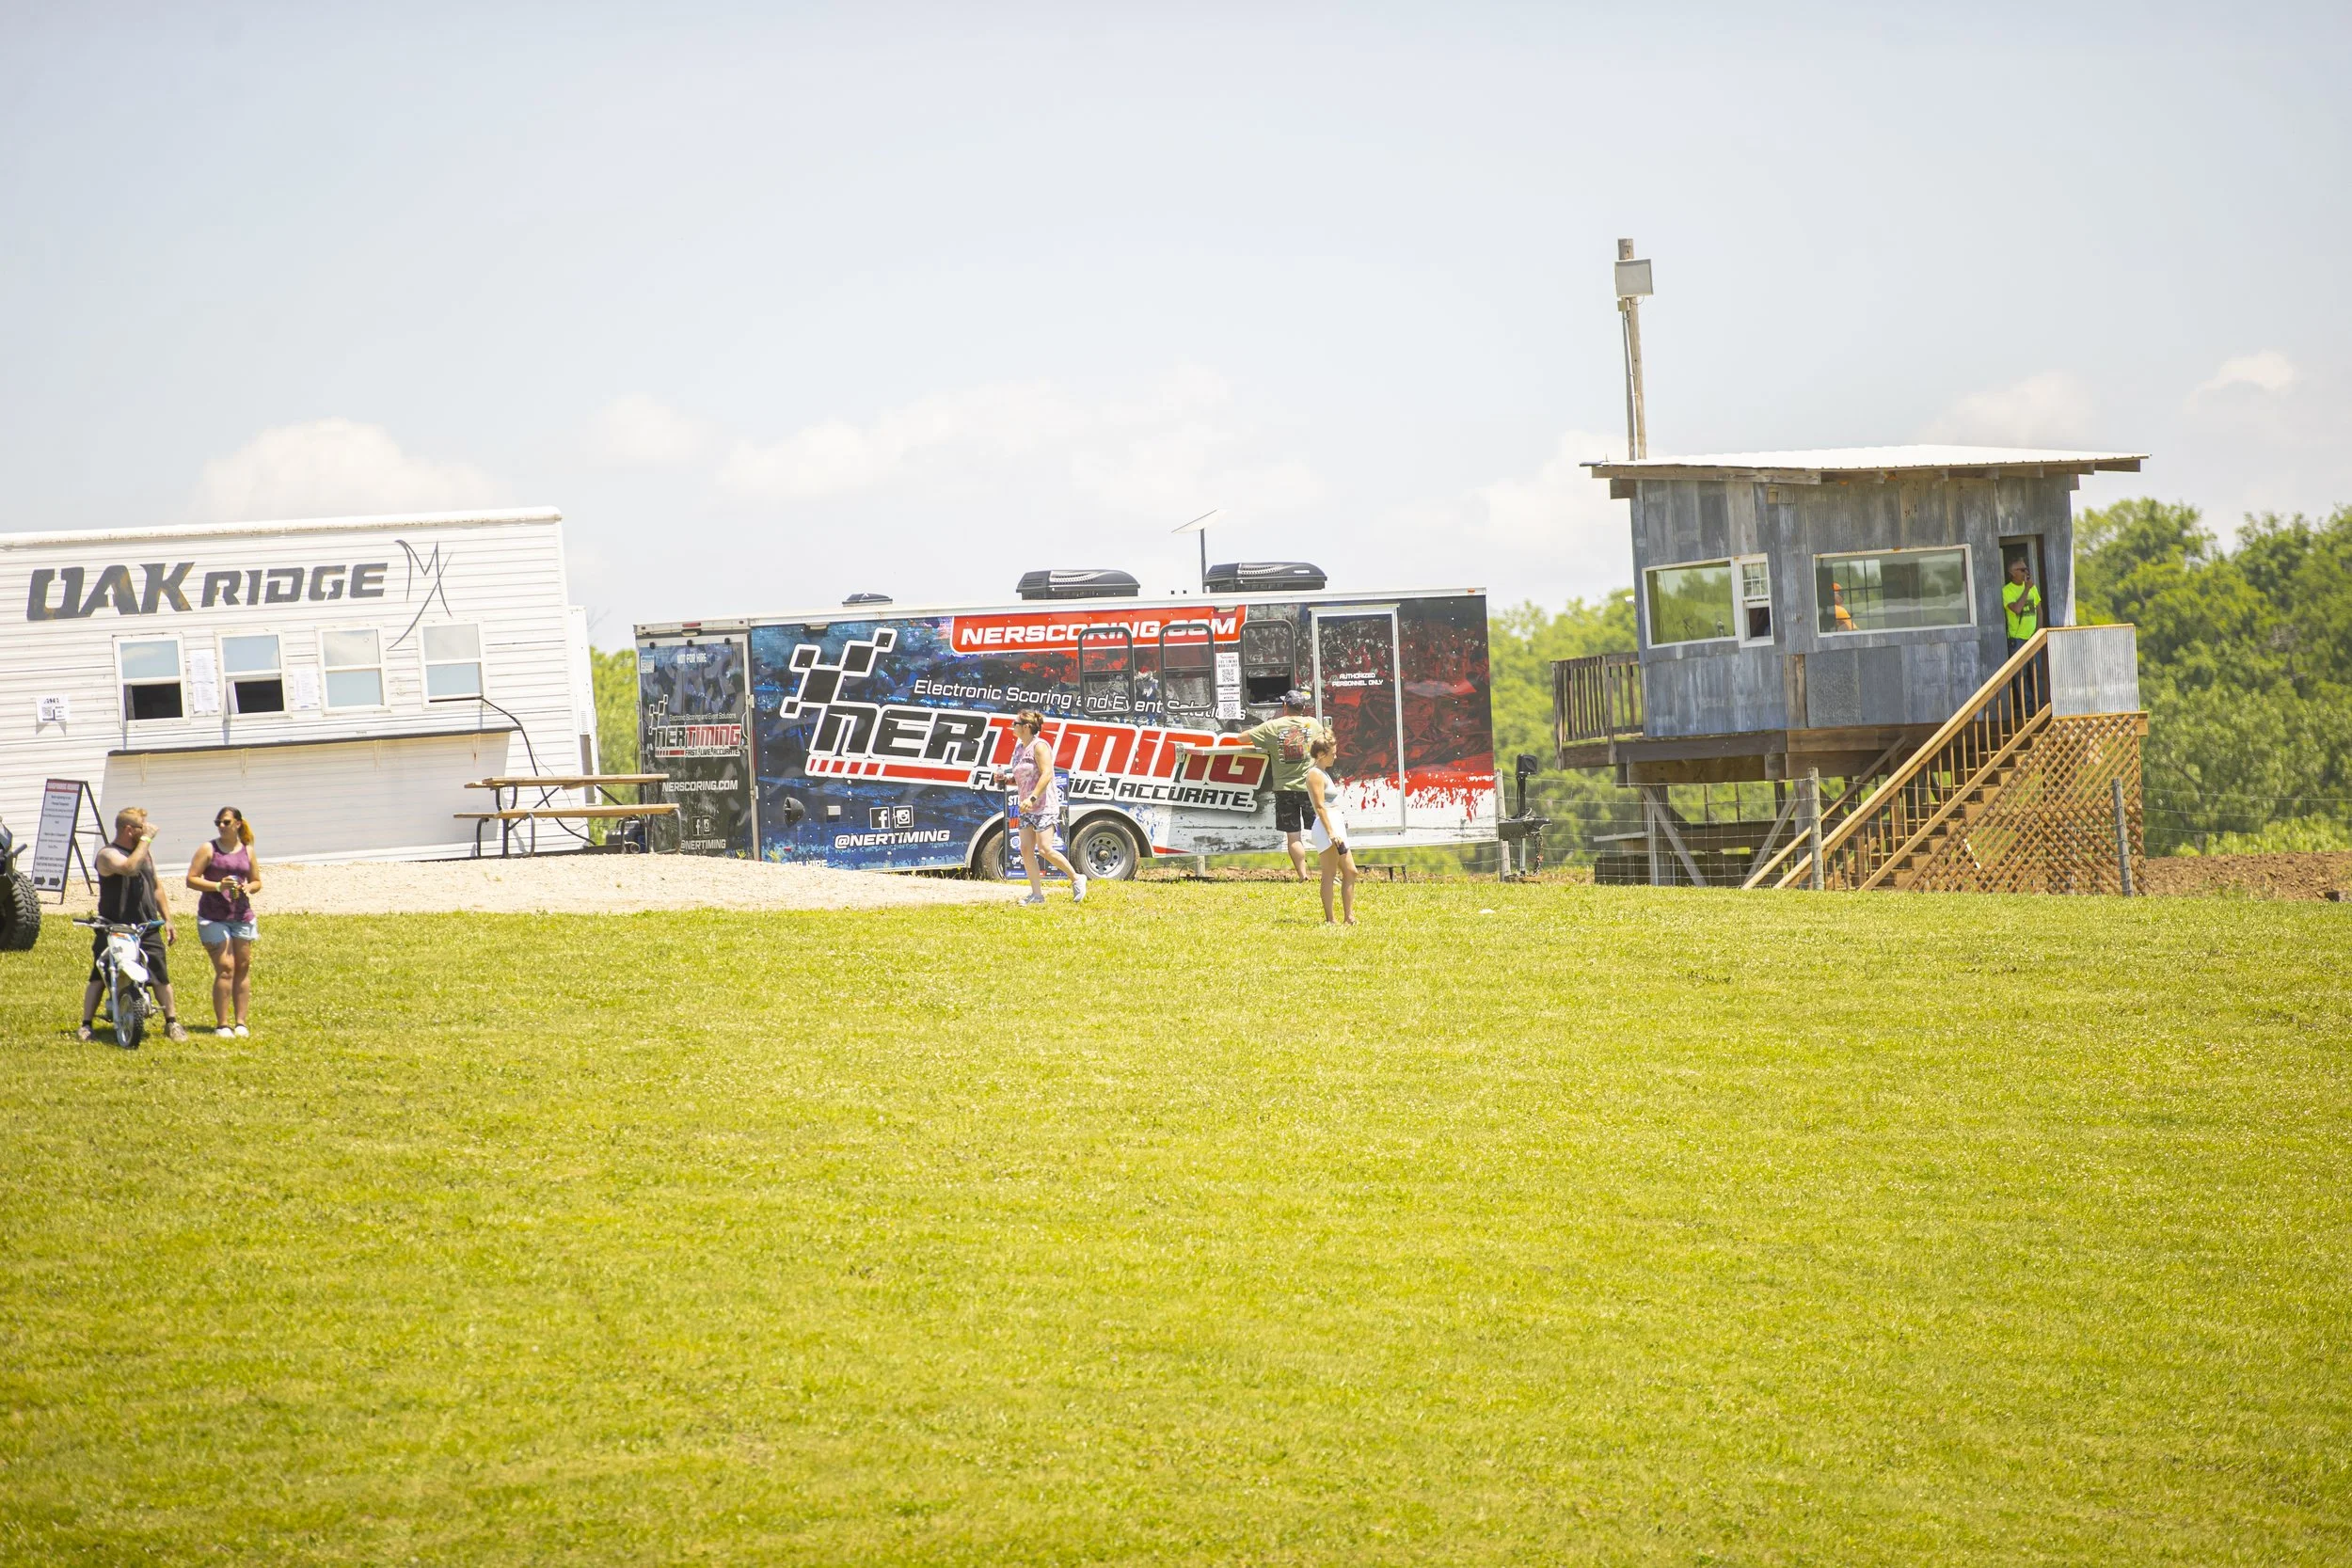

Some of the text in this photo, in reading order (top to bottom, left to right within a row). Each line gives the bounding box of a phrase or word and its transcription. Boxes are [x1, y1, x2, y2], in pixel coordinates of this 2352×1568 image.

[26, 562, 195, 621] OAK
[200, 562, 388, 608] RIDGE
[961, 617, 1236, 645] NERSCORINGCOM
[914, 679, 1002, 701] Electronic
[1006, 687, 1078, 708] Scoring
[1167, 700, 1248, 721] Solutis
[662, 780, 738, 792] NERSCORING.COM
[1069, 777, 1111, 796] IVE.
[1122, 783, 1254, 807] ACCURATE.
[835, 830, 949, 848] @NERTIMING
